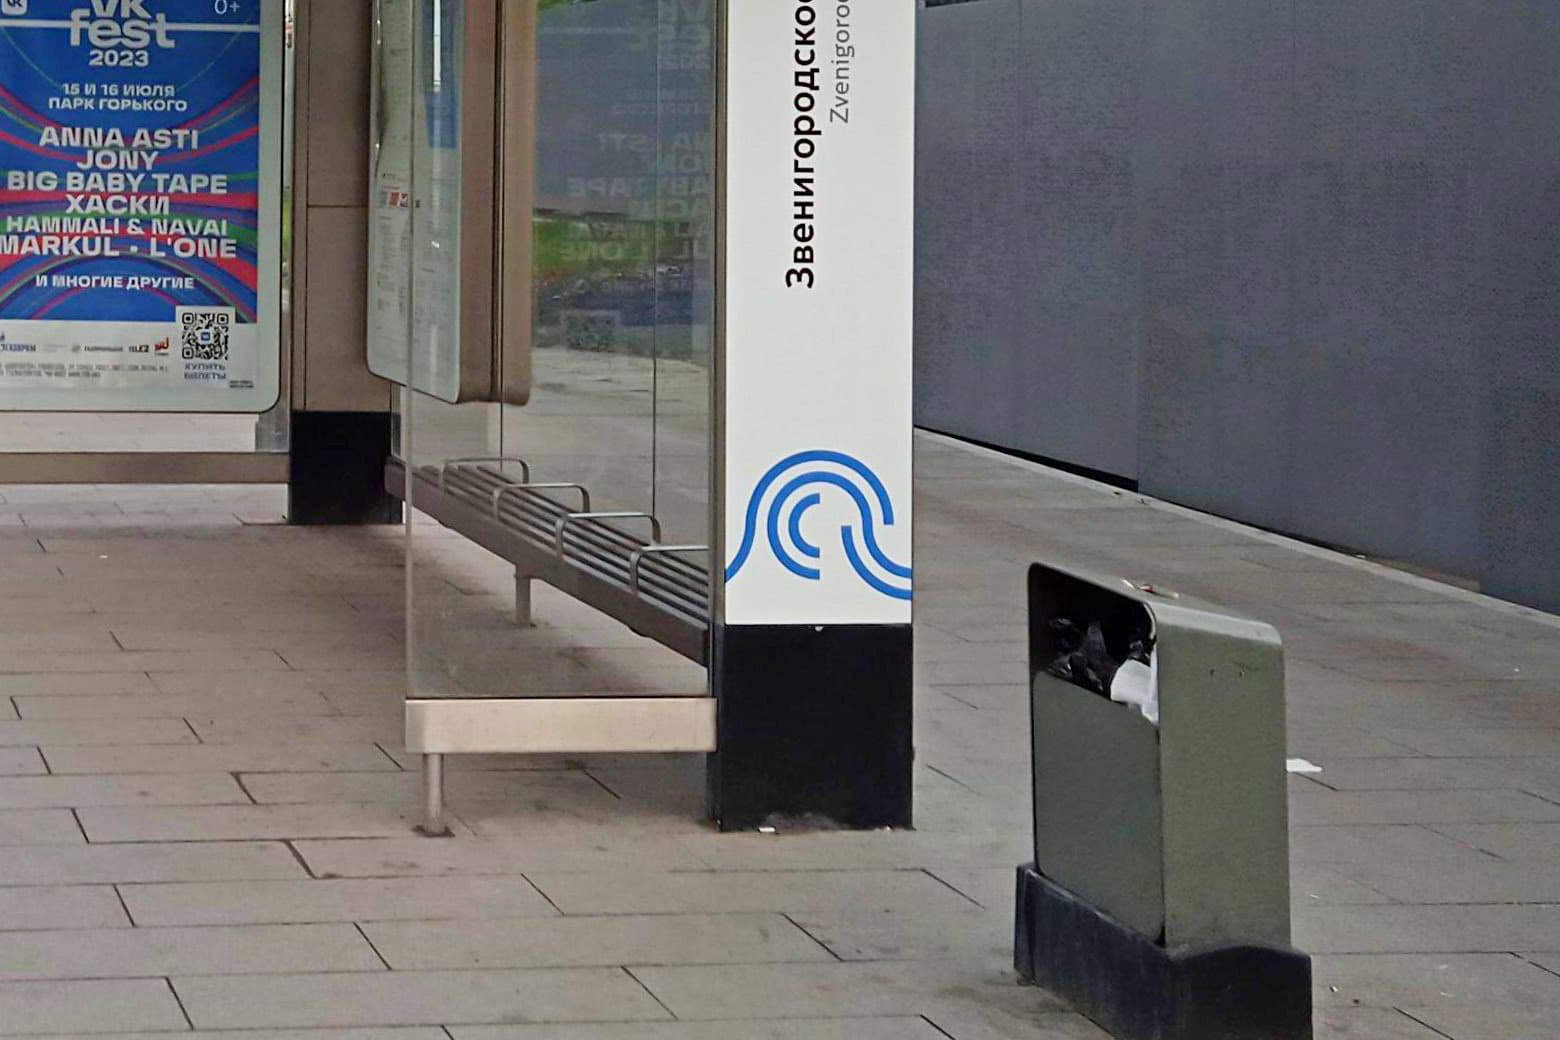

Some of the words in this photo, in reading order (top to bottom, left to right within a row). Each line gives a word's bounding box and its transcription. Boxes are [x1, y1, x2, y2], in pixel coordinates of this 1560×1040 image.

[70, 8, 176, 49] fest
[88, 49, 150, 67] 2023
[62, 83, 80, 96] 15
[84, 84, 96, 96] И
[100, 84, 118, 96] 16
[123, 85, 175, 97] ИЮЛЯ
[48, 97, 94, 110] ПАРК
[99, 98, 188, 112] ГОРЬКОГО
[40, 126, 125, 148] ANNA
[131, 128, 199, 150] ASTI
[76, 150, 159, 171] JONY
[7, 170, 58, 191] BIG
[66, 171, 145, 193] BABY
[151, 173, 228, 195] TAPE
[65, 194, 170, 216] ХАСКИ
[6, 215, 120, 235] HAMMALI
[126, 217, 145, 235] &
[151, 219, 227, 236] NAVAI
[149, 236, 237, 258] L'ONE
[36, 274, 48, 287] И
[52, 275, 125, 288] МНОГИЕ
[126, 276, 195, 291] ДРУГИЕ
